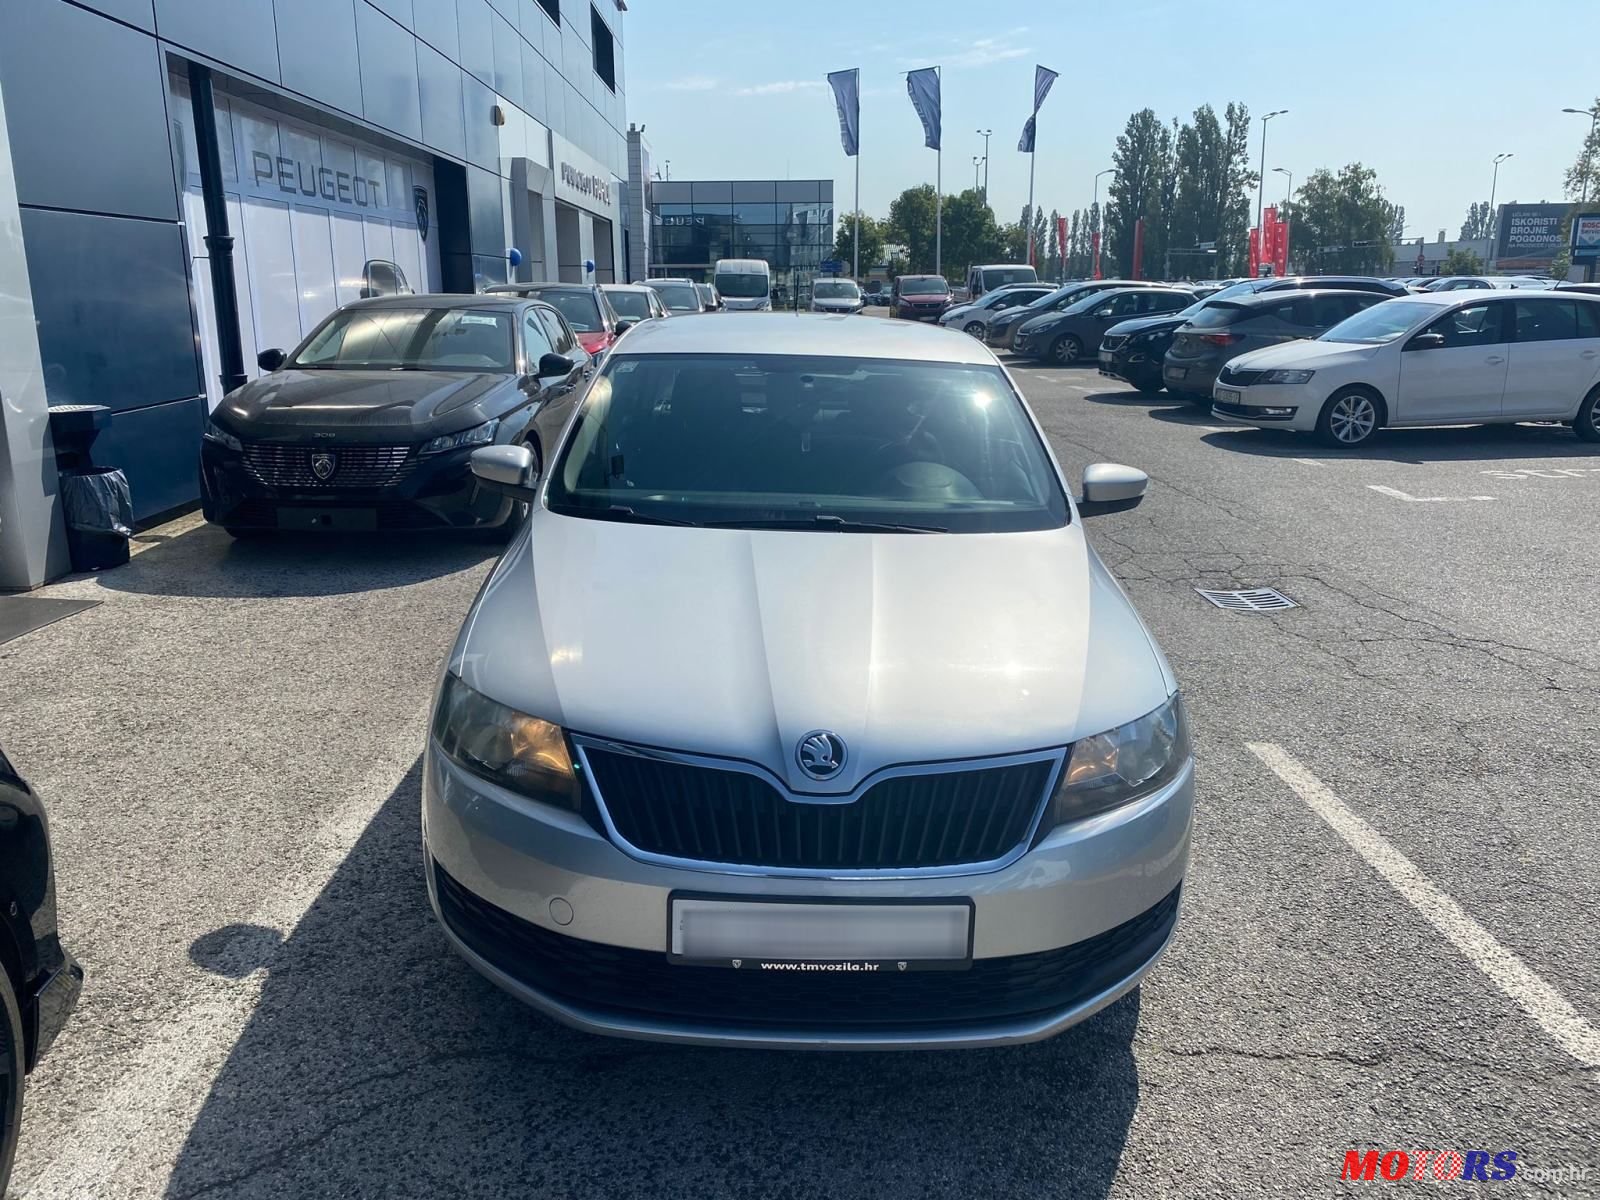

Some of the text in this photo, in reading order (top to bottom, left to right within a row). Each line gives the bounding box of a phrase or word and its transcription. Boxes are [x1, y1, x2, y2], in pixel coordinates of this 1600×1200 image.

[252, 150, 380, 209] PEUGEOT
[1511, 218, 1558, 226] ISKORISTI
[1510, 226, 1549, 234] BROJNE
[1509, 235, 1563, 243] POGODNOS
[761, 962, 879, 971] www.tmvozila.hr
